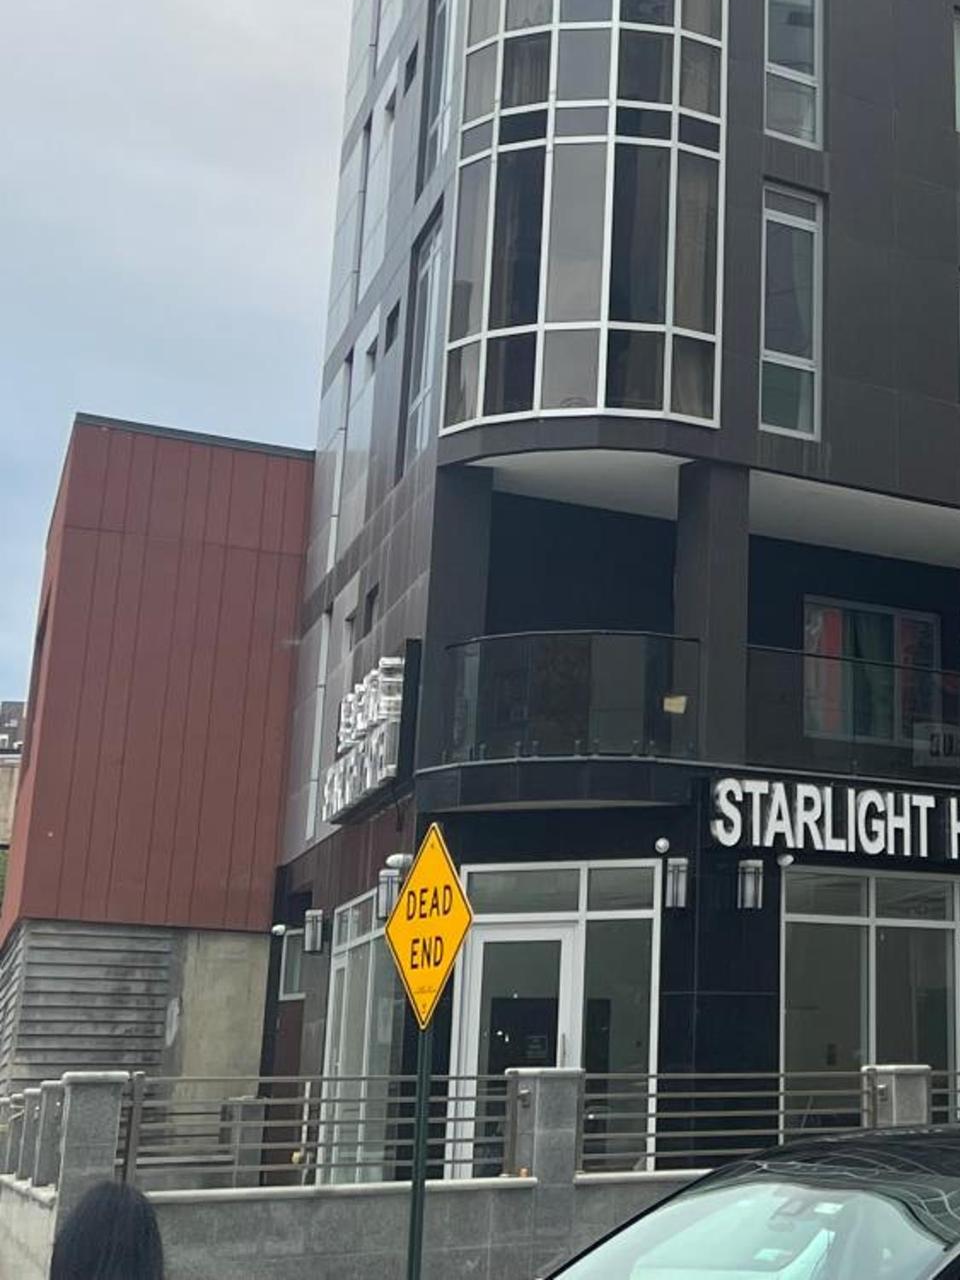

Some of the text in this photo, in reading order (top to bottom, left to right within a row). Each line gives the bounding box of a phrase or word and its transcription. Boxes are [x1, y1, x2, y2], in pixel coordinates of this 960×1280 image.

[711, 777, 936, 858] STARLIGHT
[406, 884, 453, 921] DEAD
[410, 935, 444, 969] END
